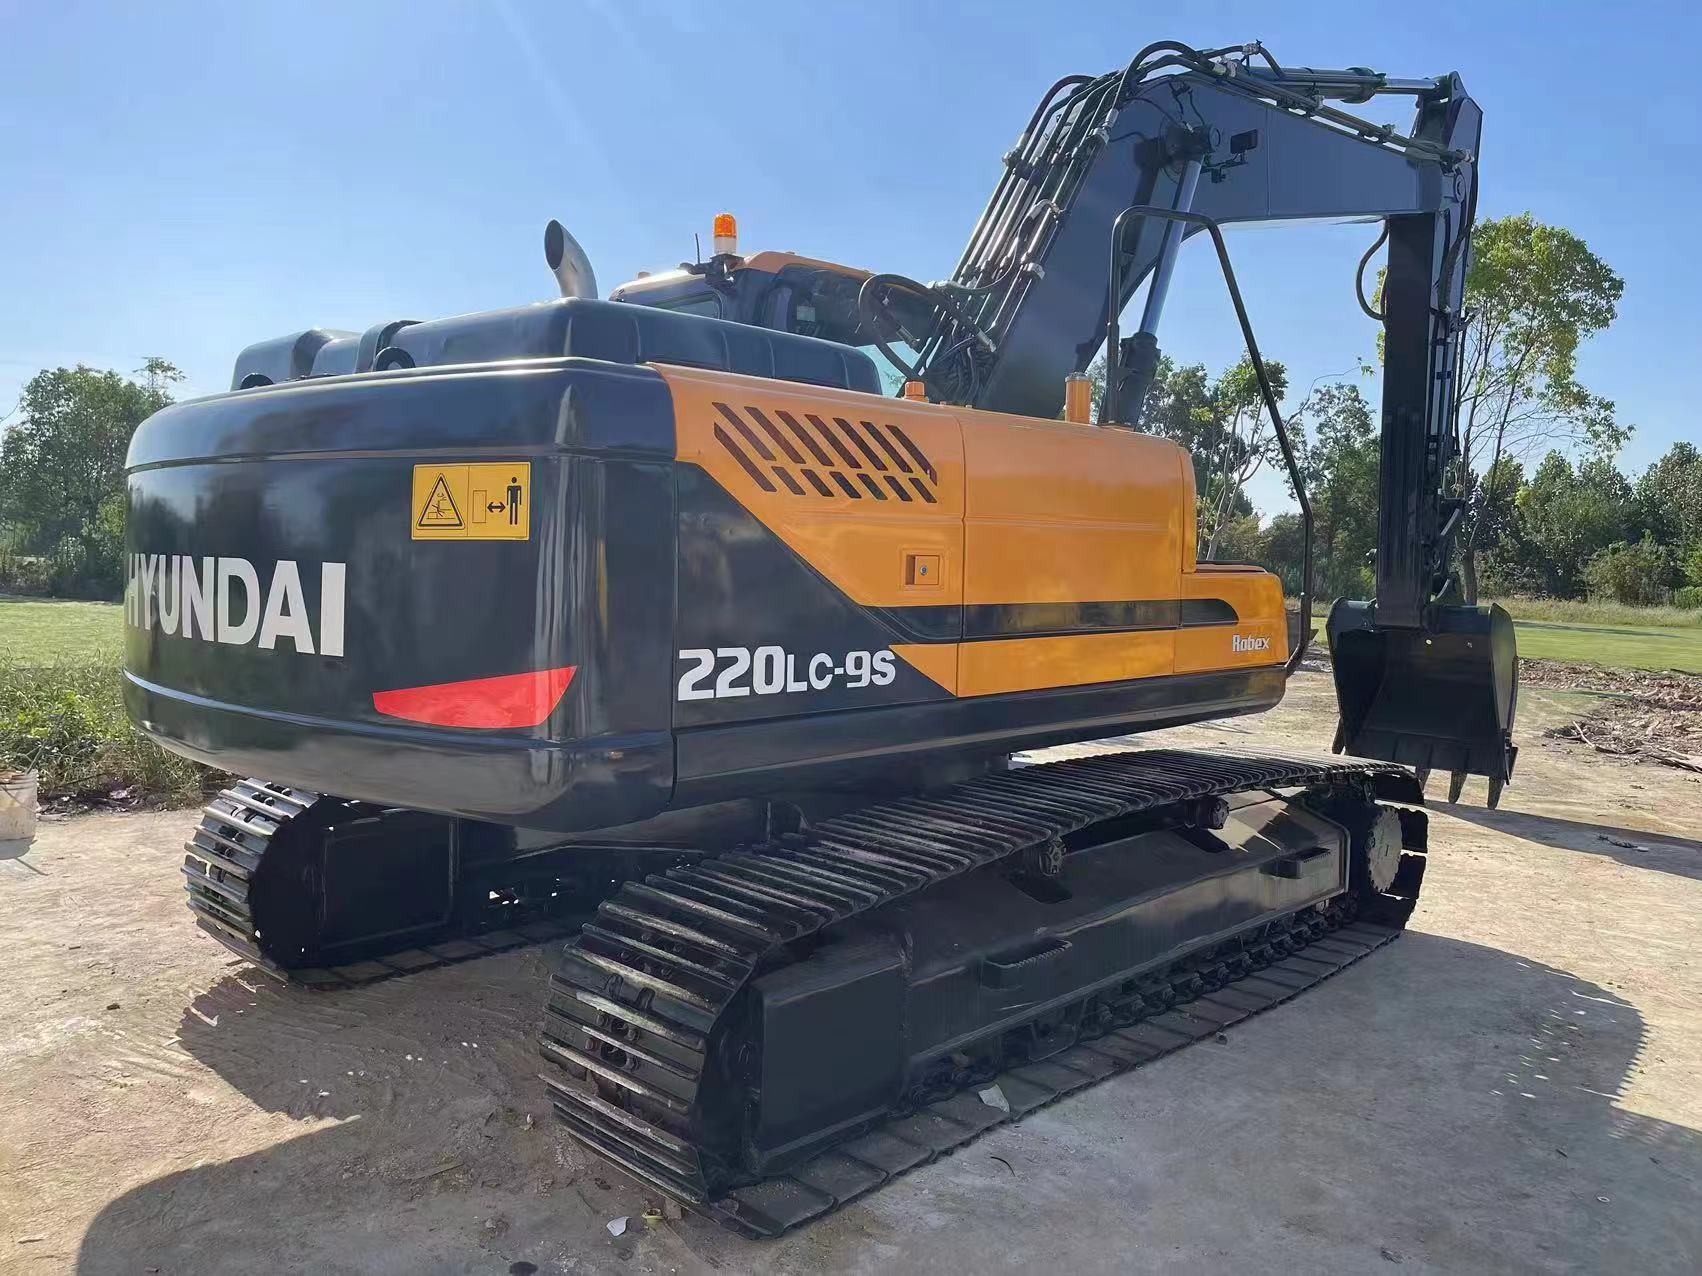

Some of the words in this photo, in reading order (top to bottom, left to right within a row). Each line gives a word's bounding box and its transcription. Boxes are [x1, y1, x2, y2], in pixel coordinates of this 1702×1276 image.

[128, 553, 346, 657] HYUNDAI
[1232, 634, 1270, 652] Robex
[677, 645, 896, 701] 220LC-9S
